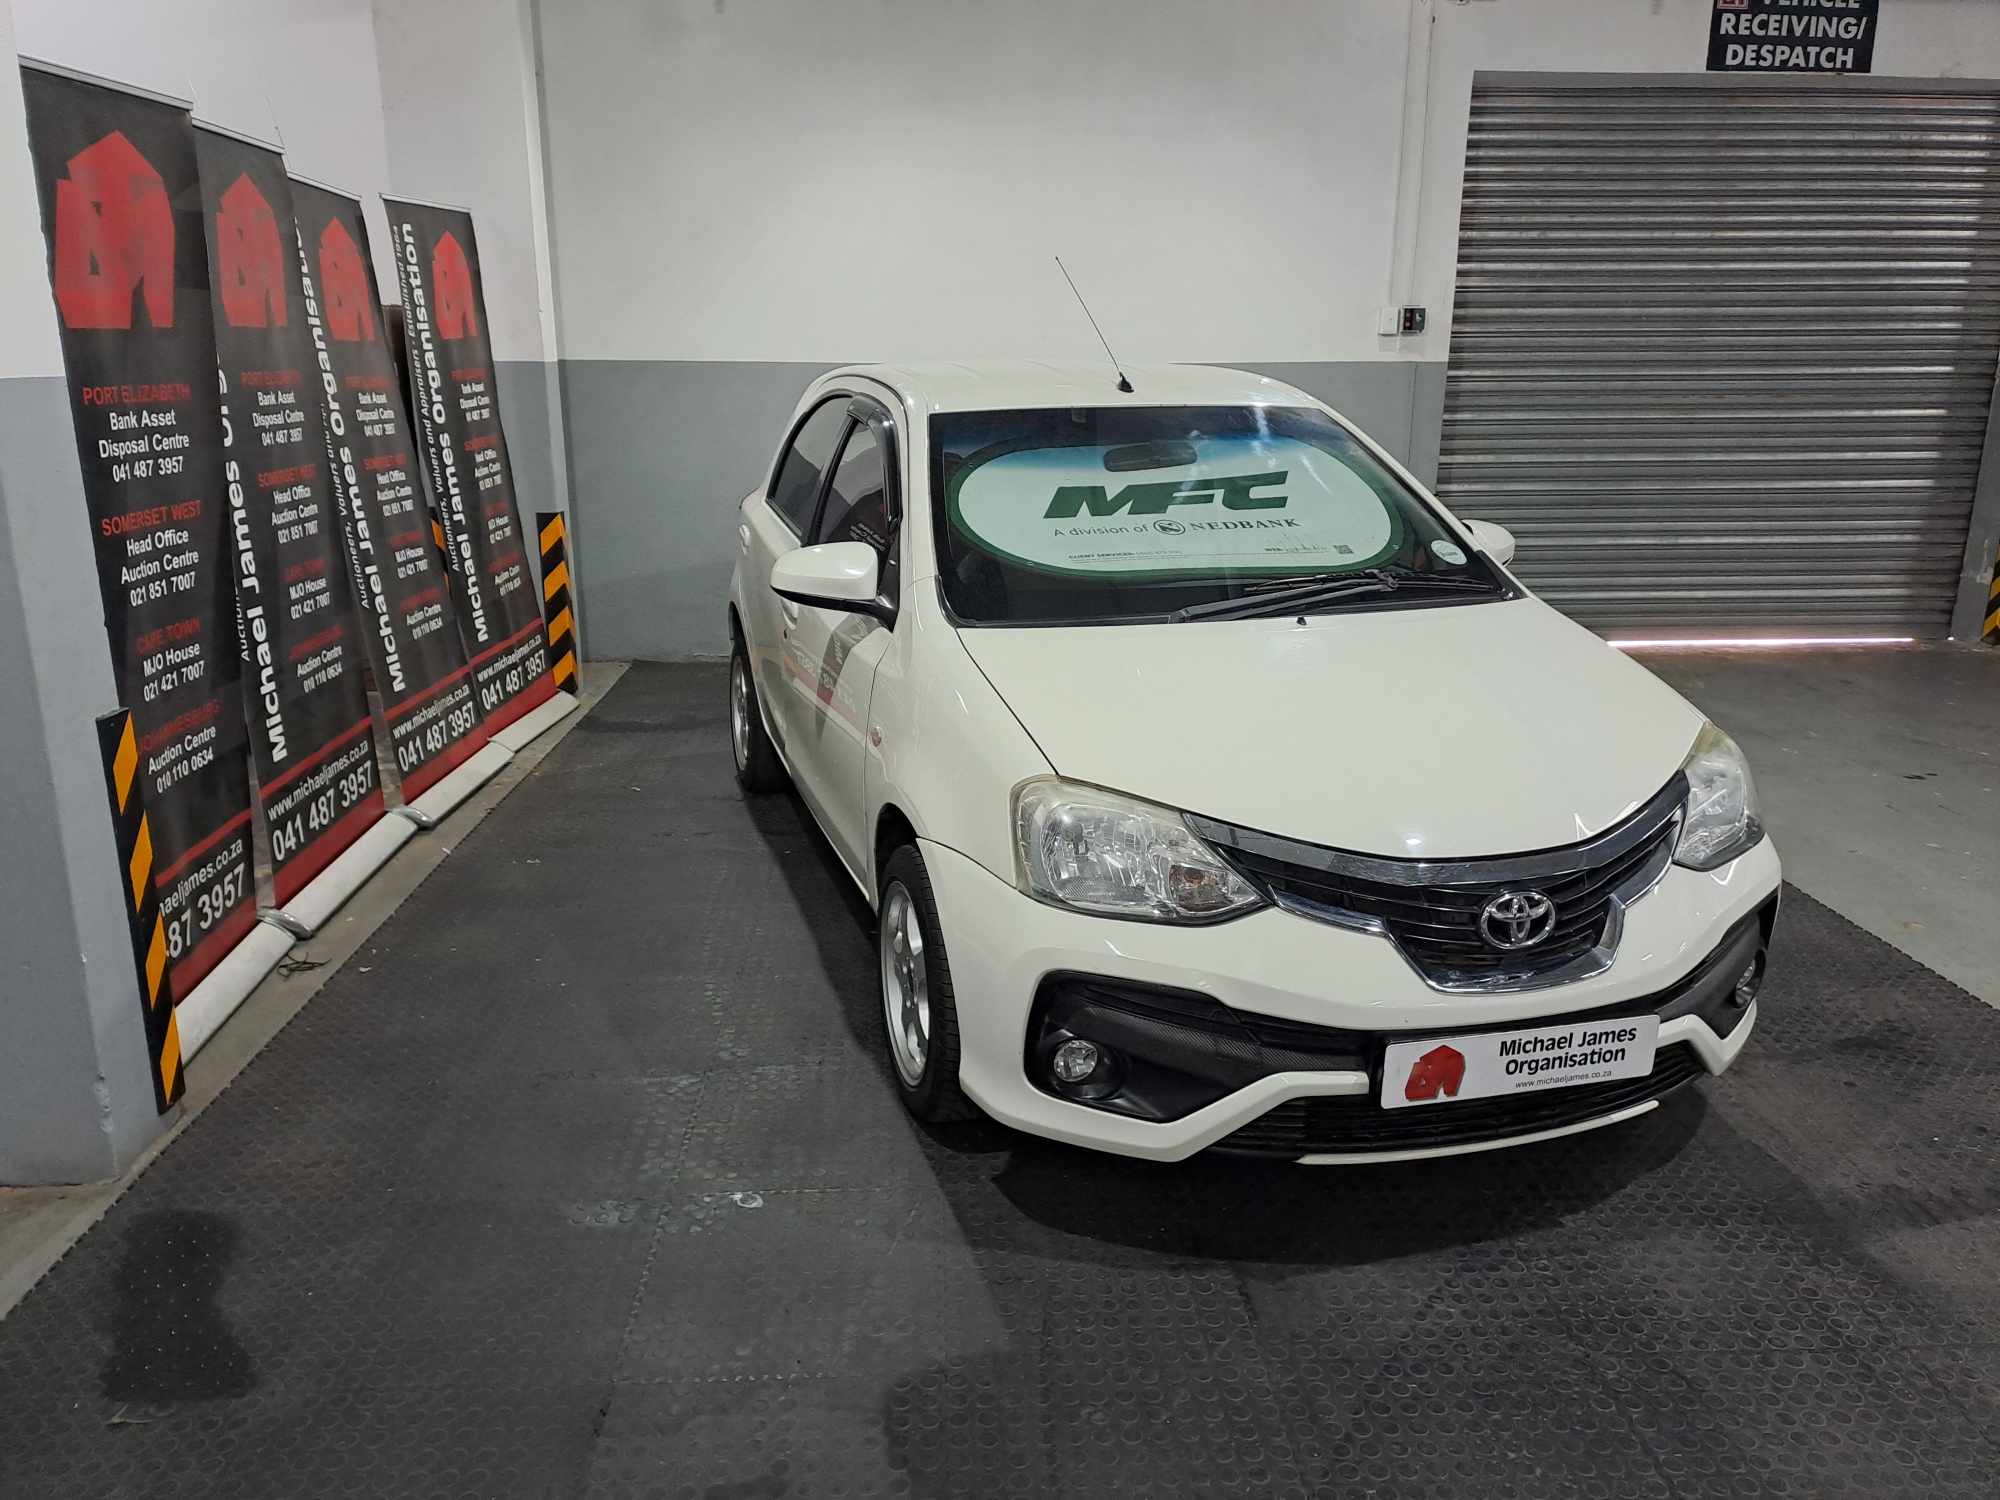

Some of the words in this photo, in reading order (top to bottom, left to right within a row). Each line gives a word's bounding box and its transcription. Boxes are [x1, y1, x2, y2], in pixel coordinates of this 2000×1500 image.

[1719, 12, 1868, 39] RECEIVING/
[1725, 43, 1854, 69] DESPATCH
[402, 223, 446, 425] Organisation
[257, 390, 277, 406] Bank
[411, 349, 432, 416] Appraisers
[109, 410, 139, 431] Bank
[141, 408, 177, 428] Asset
[252, 410, 285, 429] Disposal
[261, 430, 274, 446] 041
[275, 429, 288, 444] 487
[422, 418, 435, 445] and
[98, 434, 149, 460] Disposal
[152, 433, 190, 452] Centre
[112, 462, 131, 482] 041
[133, 459, 154, 478] 487
[157, 455, 183, 475] 3957
[431, 446, 444, 494] Valuers
[439, 431, 466, 526] James
[273, 488, 292, 505] Head
[329, 462, 348, 516] Valuers
[339, 446, 374, 555] James
[1043, 470, 1288, 519] MFC
[101, 506, 168, 536] SOMERSET
[170, 499, 201, 520] WEST
[225, 460, 260, 594] James
[271, 508, 298, 526] Auction
[278, 527, 291, 544] 021
[290, 524, 304, 540] 851
[1054, 528, 1065, 537] A
[1069, 526, 1130, 536] division
[1133, 524, 1149, 533] of
[1189, 518, 1301, 531] NEDBANK
[126, 533, 152, 557] Head
[154, 528, 189, 549] Office
[120, 559, 161, 585] Auction
[162, 549, 200, 572] Centre
[346, 520, 370, 609] Auctioneers,
[130, 586, 148, 607] 021
[148, 578, 168, 600] 851
[170, 571, 196, 593] 7007
[289, 582, 305, 600] MJO
[304, 577, 327, 594] House
[456, 533, 488, 643] Michael
[290, 602, 303, 620] 021
[364, 564, 406, 693] Michael
[143, 654, 164, 678] MJO
[165, 643, 200, 666] House
[297, 655, 322, 678] Auction
[143, 679, 159, 702] 021
[160, 670, 178, 692] 421
[181, 659, 206, 682] 7007
[246, 605, 288, 763] Michael
[481, 679, 505, 711] 041
[505, 667, 524, 694] 487
[525, 648, 547, 681] 3957
[148, 742, 182, 775] Auction
[184, 725, 217, 751] Centre
[398, 735, 424, 772] 041
[426, 719, 448, 753] 487
[447, 700, 477, 738] 3957
[156, 769, 172, 794] 010
[172, 759, 189, 781] 110
[190, 746, 214, 770] 0634
[267, 740, 369, 821] www.michaeljames.co.za
[272, 812, 305, 861] 041
[309, 788, 335, 831] 487
[339, 759, 372, 807] 3957
[197, 862, 245, 930] 3957
[1499, 1032, 1574, 1057] Michael
[1577, 1026, 1638, 1048] James
[1505, 1047, 1626, 1076] Organisation
[1515, 1070, 1612, 1089] www.michaeljames.co.za
